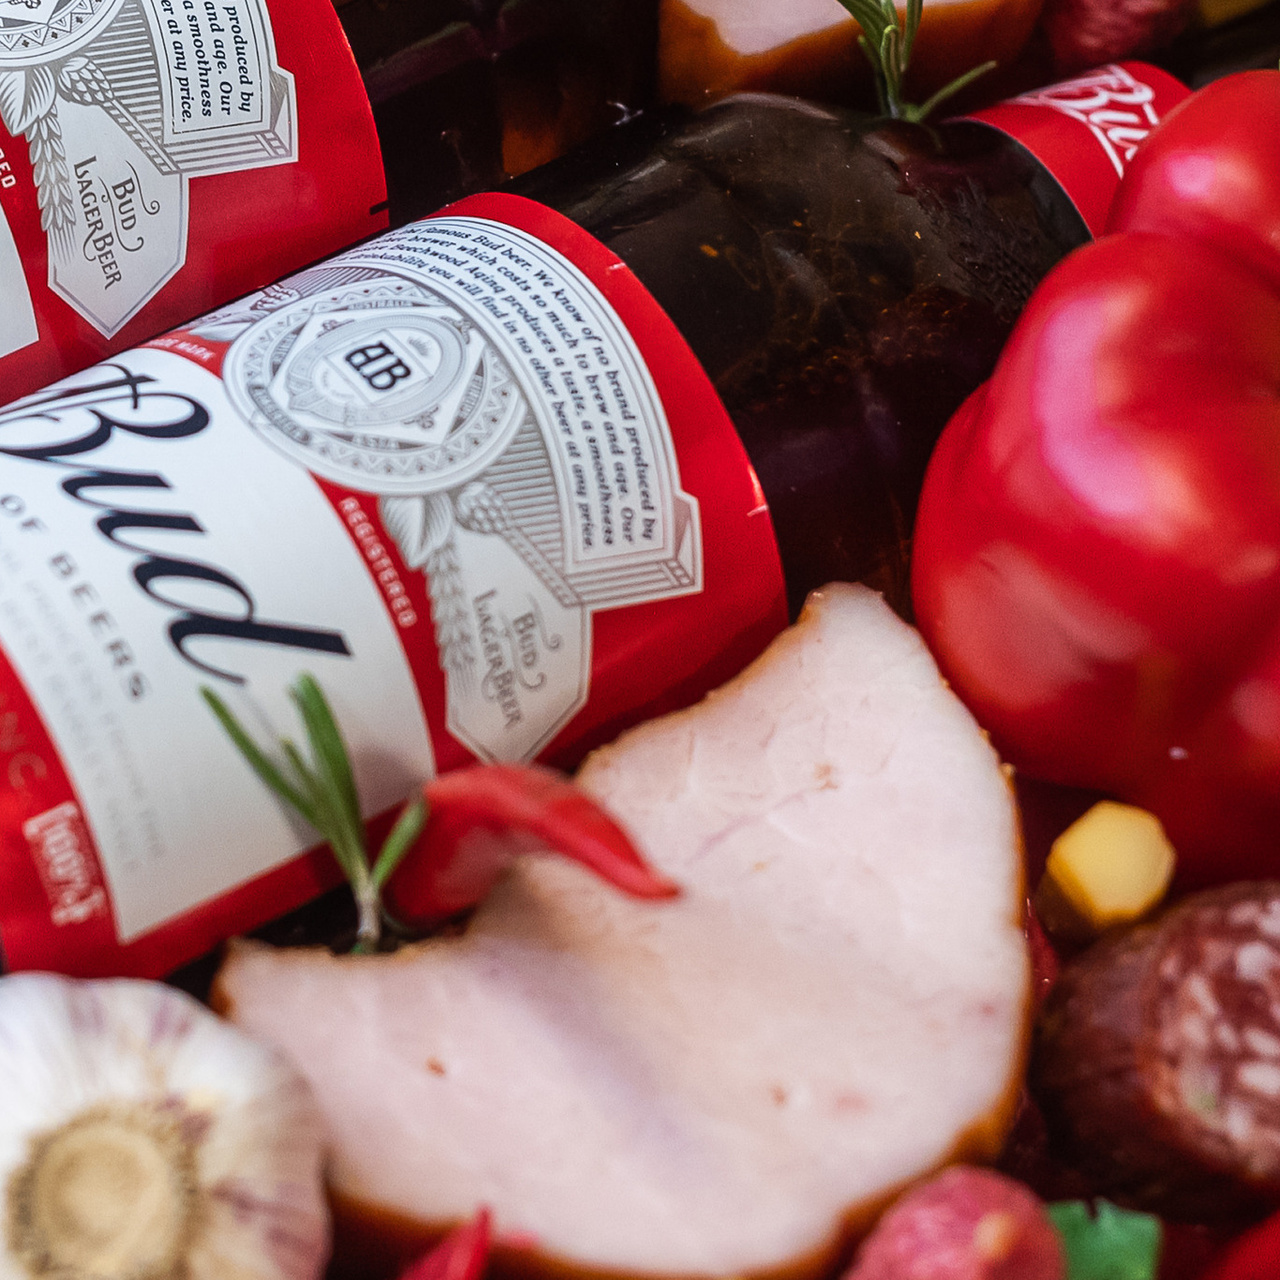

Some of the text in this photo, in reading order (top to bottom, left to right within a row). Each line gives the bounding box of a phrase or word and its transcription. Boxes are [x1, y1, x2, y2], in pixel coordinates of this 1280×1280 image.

[167, 19, 182, 35] at
[182, 0, 194, 9] a
[204, 0, 225, 33] and
[172, 40, 187, 71] any
[187, 14, 212, 117] smoothness
[213, 38, 228, 75] age.
[223, 5, 254, 86] produced
[175, 75, 194, 123] price.
[219, 81, 233, 116] Our
[238, 91, 254, 113] by
[1008, 65, 1154, 161] Bu
[112, 178, 138, 231] BUD
[464, 266, 507, 294] Aging
[501, 294, 556, 353] produces
[457, 245, 498, 266] which
[497, 266, 531, 292] costs
[529, 294, 547, 308] so
[545, 310, 579, 350] much
[574, 353, 589, 370] to
[585, 374, 610, 416] brew
[603, 421, 625, 456] and
[472, 235, 505, 251] Bud
[500, 247, 533, 272] beer.
[533, 269, 555, 287] We
[552, 288, 585, 323] know
[581, 327, 603, 342] of
[593, 346, 609, 366] no
[605, 370, 636, 421] brand
[623, 426, 655, 511] produced
[642, 517, 656, 540] by
